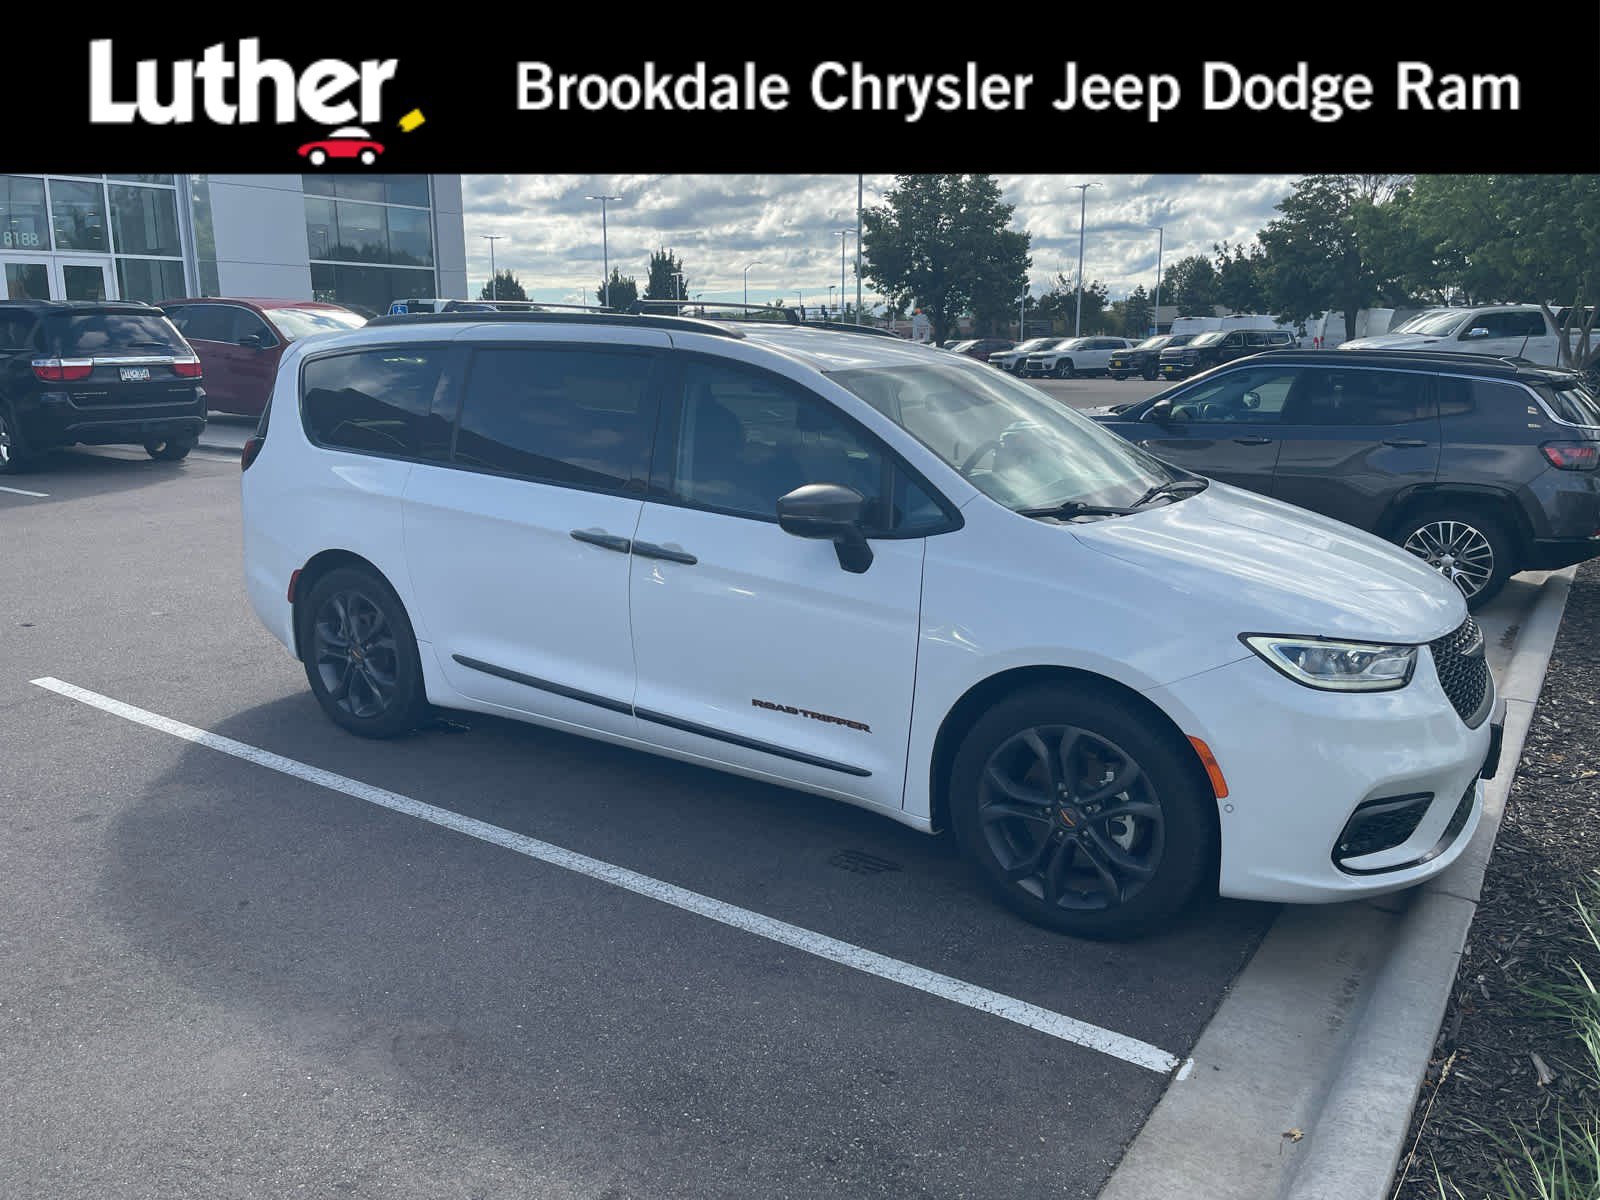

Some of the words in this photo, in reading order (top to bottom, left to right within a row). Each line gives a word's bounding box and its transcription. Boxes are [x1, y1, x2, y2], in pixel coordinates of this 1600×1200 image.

[3, 231, 40, 247] 8188
[752, 698, 799, 716] ROAD
[799, 708, 873, 734] TRIPPER
